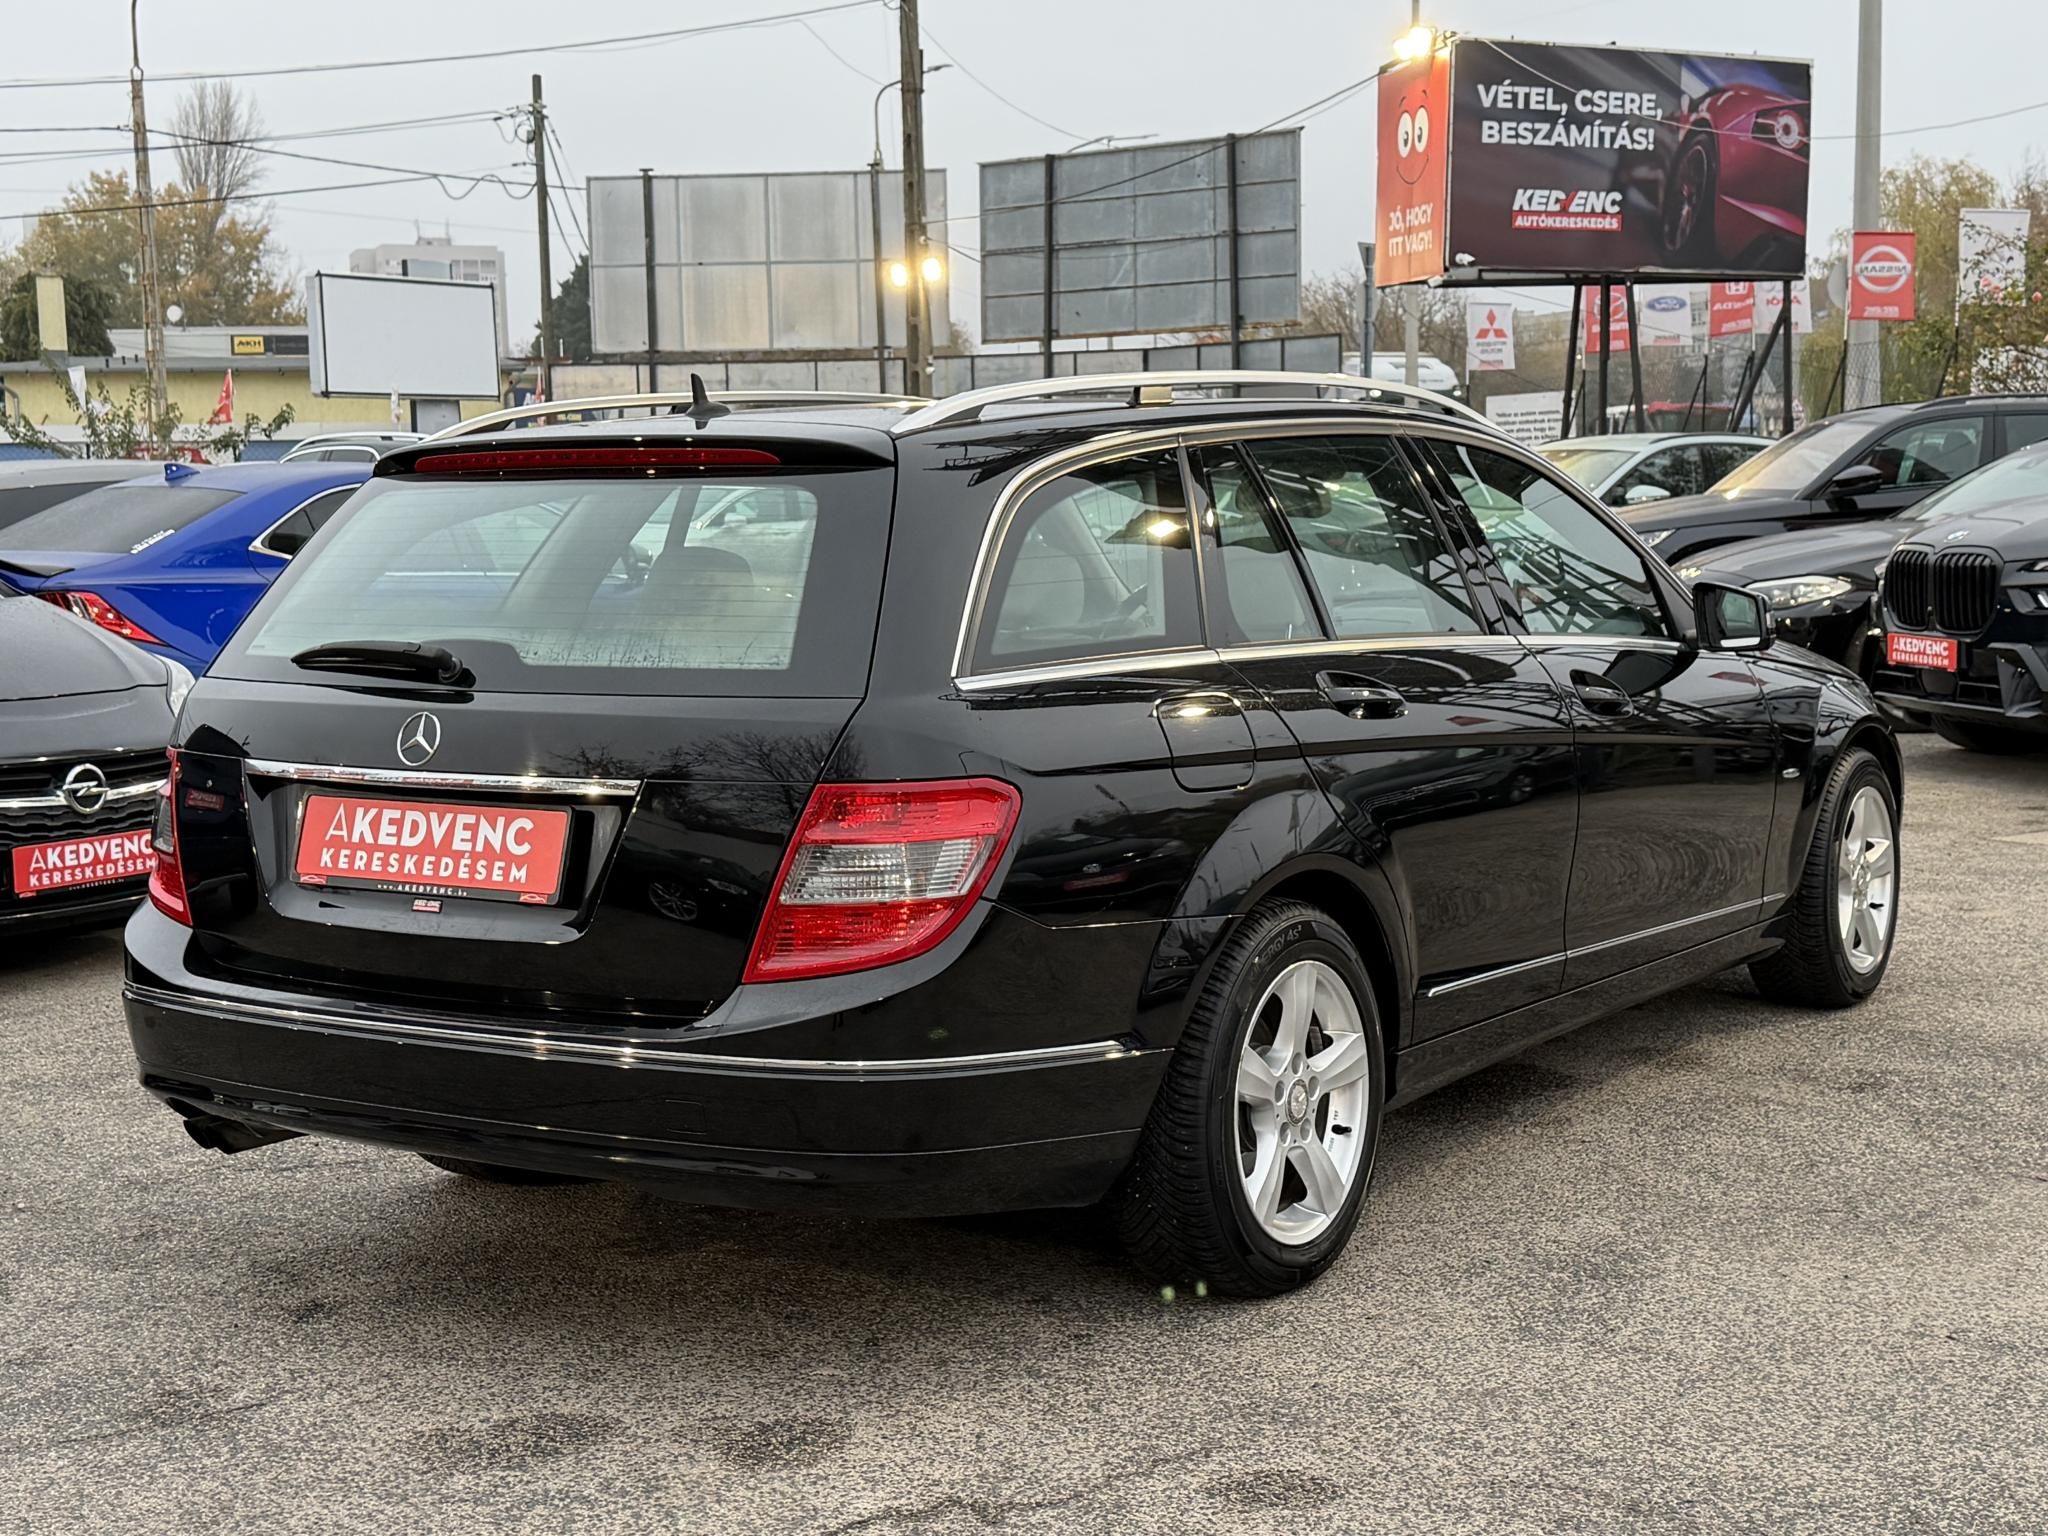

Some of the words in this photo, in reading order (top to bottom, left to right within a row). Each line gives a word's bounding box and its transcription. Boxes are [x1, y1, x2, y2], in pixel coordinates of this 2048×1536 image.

[1477, 79, 1568, 116] VÉTEL,
[1575, 89, 1663, 120] CSERE,
[1481, 116, 1656, 151] BESZÁMÍTÁS!
[1389, 204, 1404, 233] JÓ,
[1406, 202, 1433, 229] HOGY
[1514, 214, 1620, 229] AUTÓKERESKEDÉS
[1388, 236, 1403, 258] ITT
[1404, 229, 1433, 254] VAGY!
[1893, 636, 1949, 657] AKEDVENC
[324, 802, 535, 856] AKEDVENC
[30, 833, 154, 872] AKEDVENC
[320, 847, 529, 885] KERESKEDÉSEM
[29, 856, 157, 888] KERESKEDÉSEM
